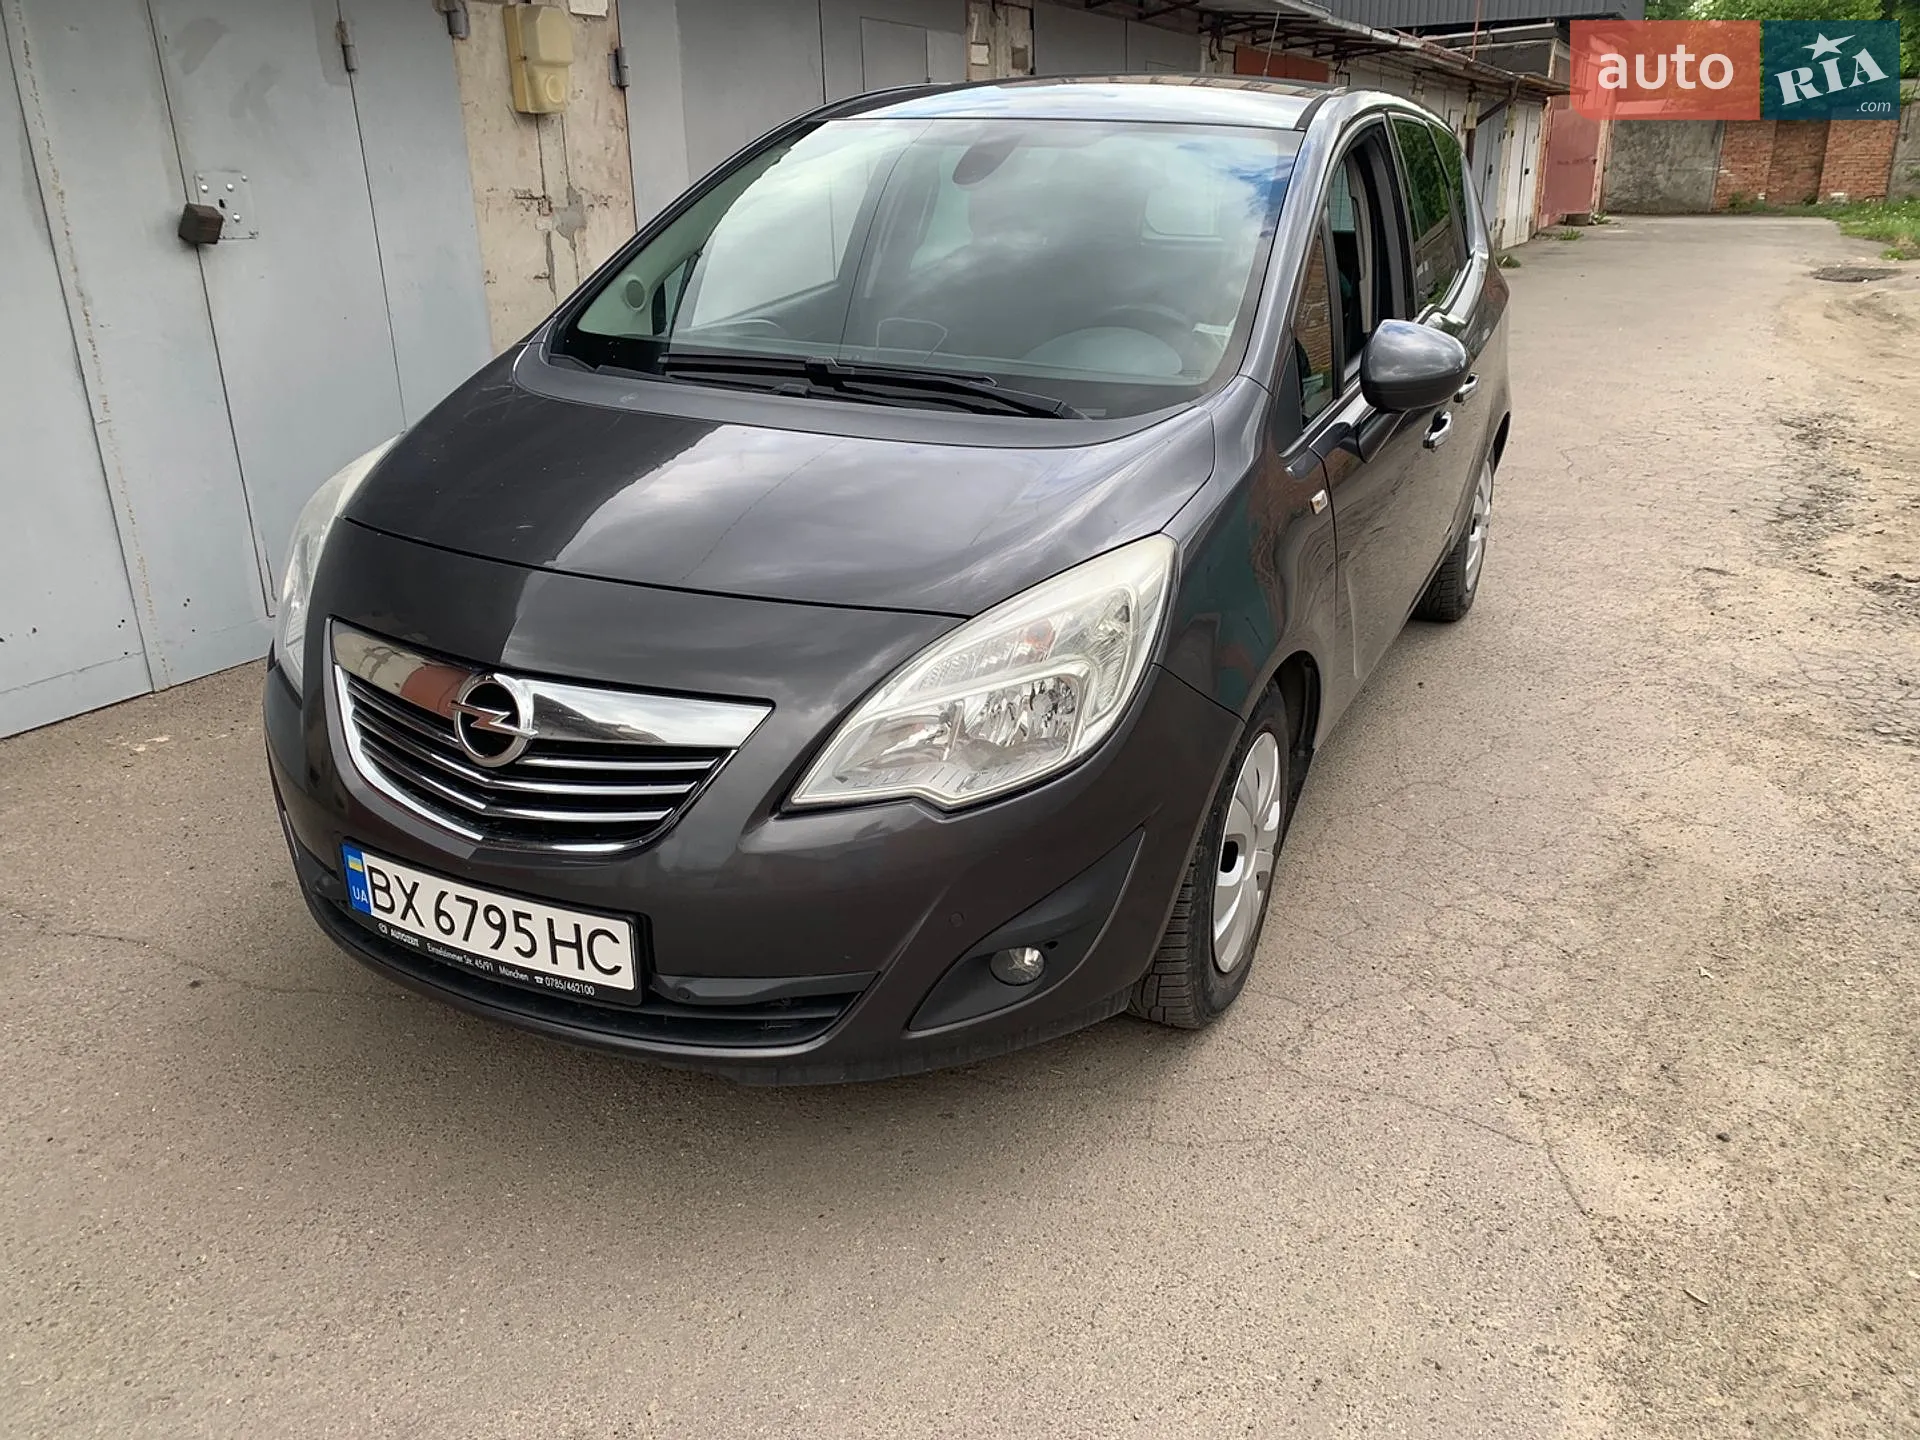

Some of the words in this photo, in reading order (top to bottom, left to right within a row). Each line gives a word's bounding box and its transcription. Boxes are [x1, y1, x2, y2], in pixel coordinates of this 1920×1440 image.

[352, 885, 369, 904] UA
[367, 864, 426, 928] BX
[434, 890, 537, 958] 6795
[547, 917, 623, 975] HC
[499, 965, 529, 982] München
